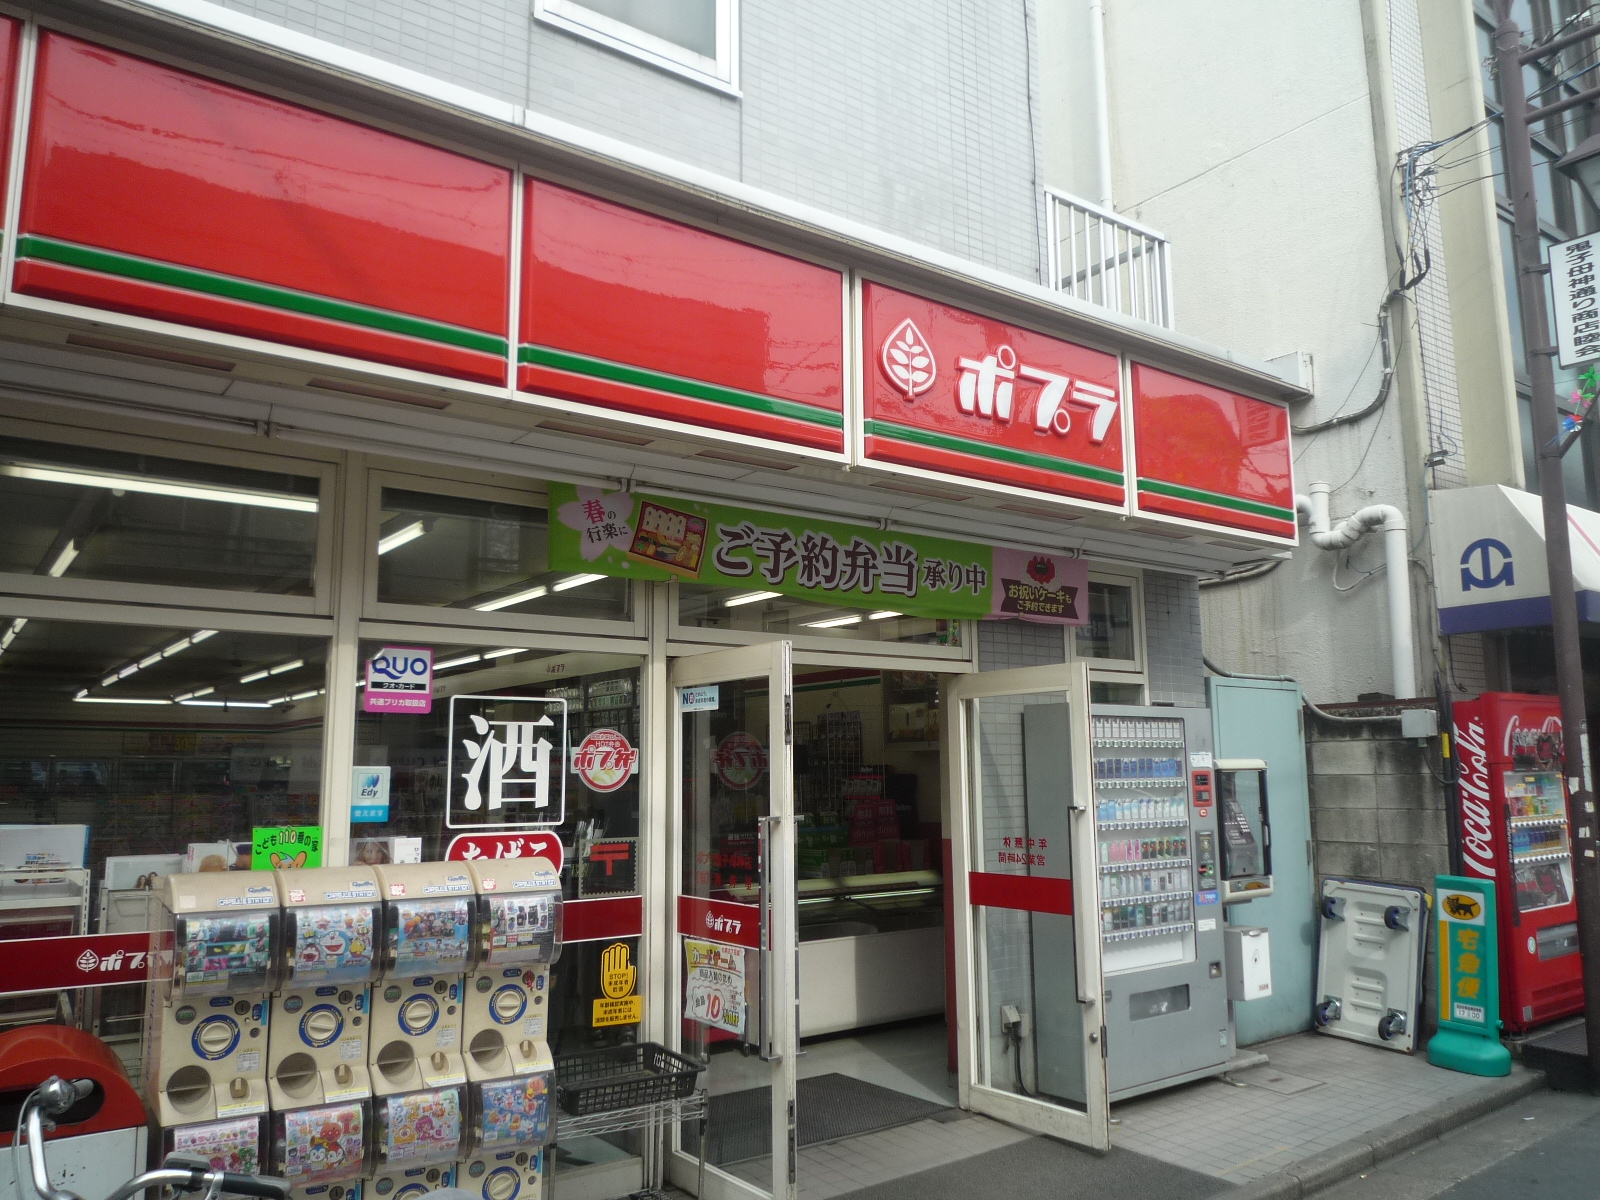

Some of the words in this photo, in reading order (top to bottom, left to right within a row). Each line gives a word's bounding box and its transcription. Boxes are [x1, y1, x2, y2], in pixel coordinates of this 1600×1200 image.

[954, 344, 1119, 445] ポプラ
[581, 498, 617, 524] 春の
[587, 523, 628, 544] 行楽に
[1008, 583, 1073, 605] お祝いケーキも
[1016, 599, 1065, 614] ご予約できます
[371, 655, 428, 680] QUO
[382, 682, 416, 690] クオ・カード
[369, 697, 427, 708] 共通プリカ取扱店
[461, 714, 555, 811] 酒
[360, 788, 379, 798] Edy
[714, 914, 742, 936] ポプラ
[100, 949, 148, 973] ポプ
[608, 972, 629, 980] STOP!
